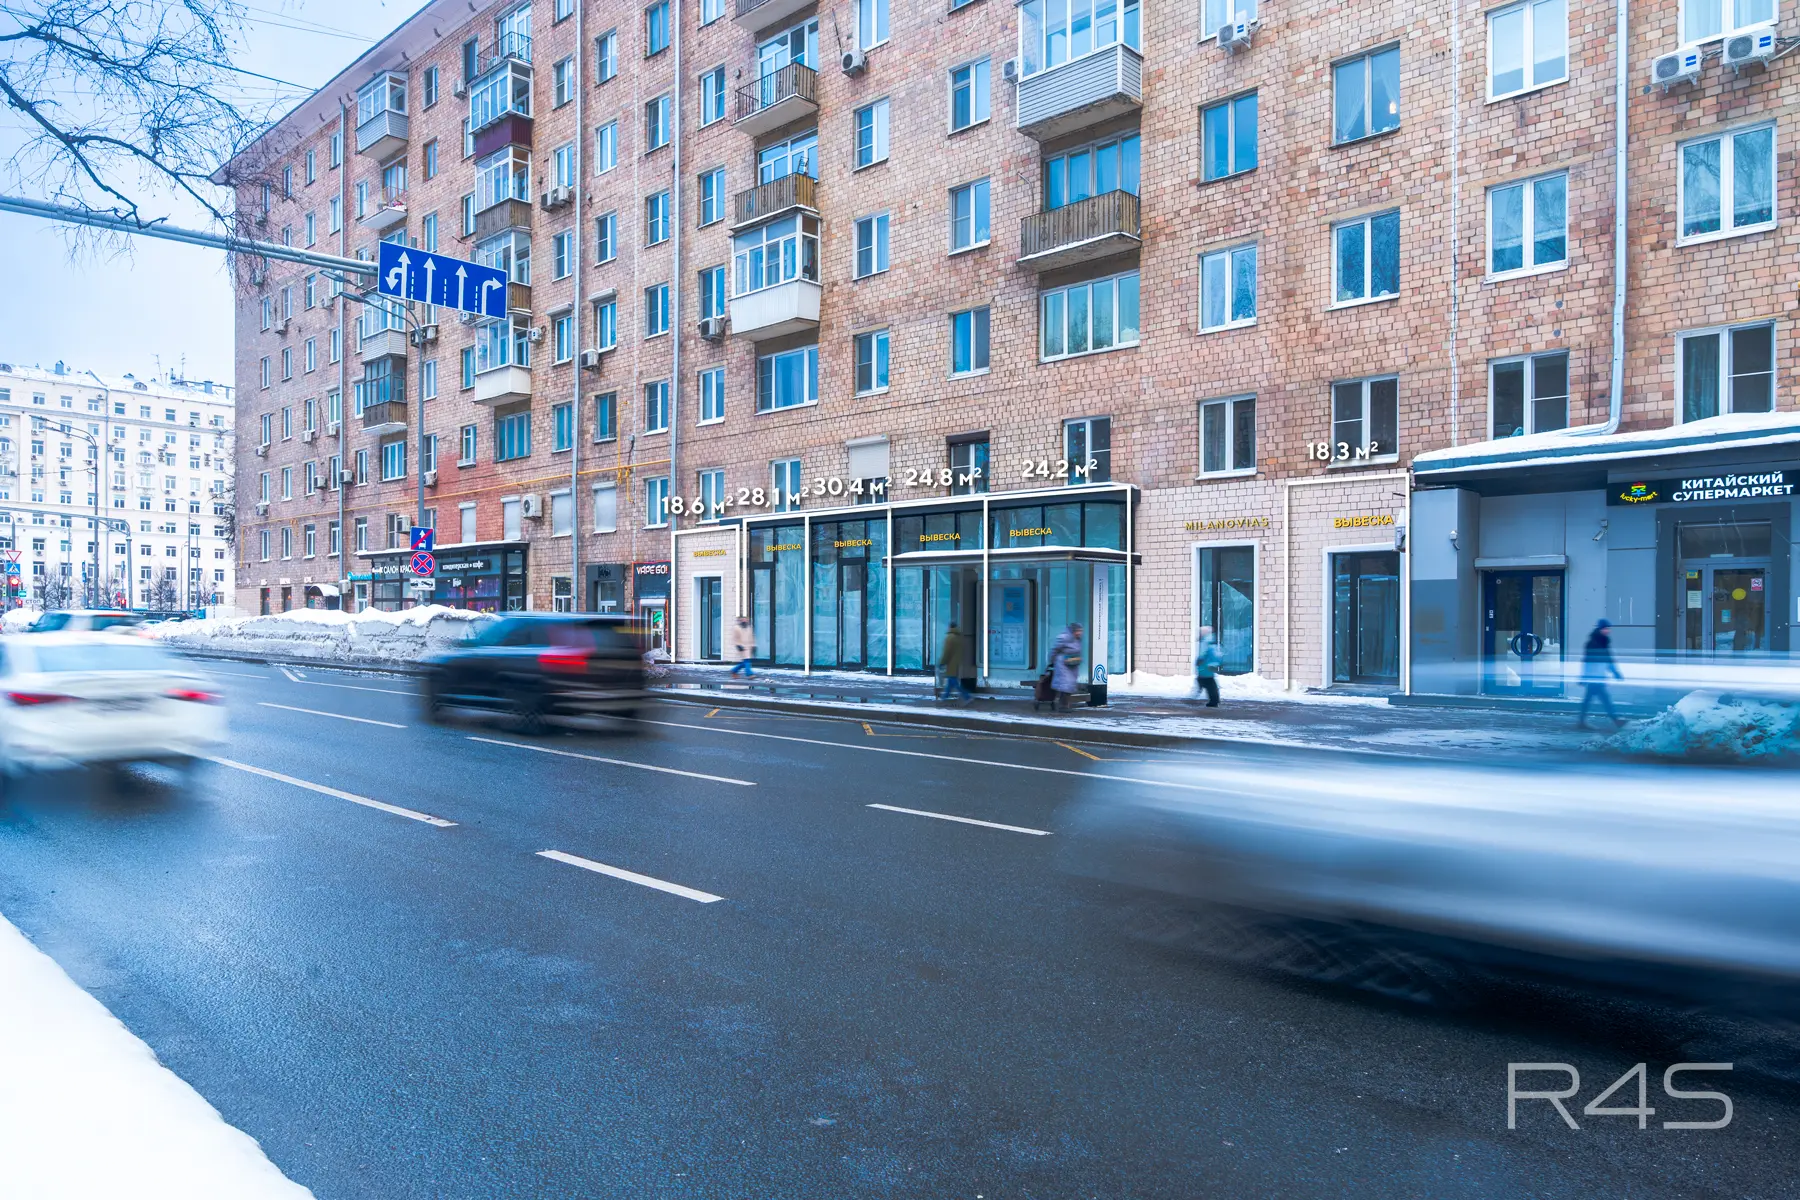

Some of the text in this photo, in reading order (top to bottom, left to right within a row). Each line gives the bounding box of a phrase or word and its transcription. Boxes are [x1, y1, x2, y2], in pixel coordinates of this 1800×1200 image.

[1681, 471, 1783, 490] КИТАЙСКИЙ
[1672, 484, 1794, 502] СУПЕРМАРКЕТ
[1185, 516, 1269, 531] MILANOVIAS
[636, 565, 655, 575] VAPE
